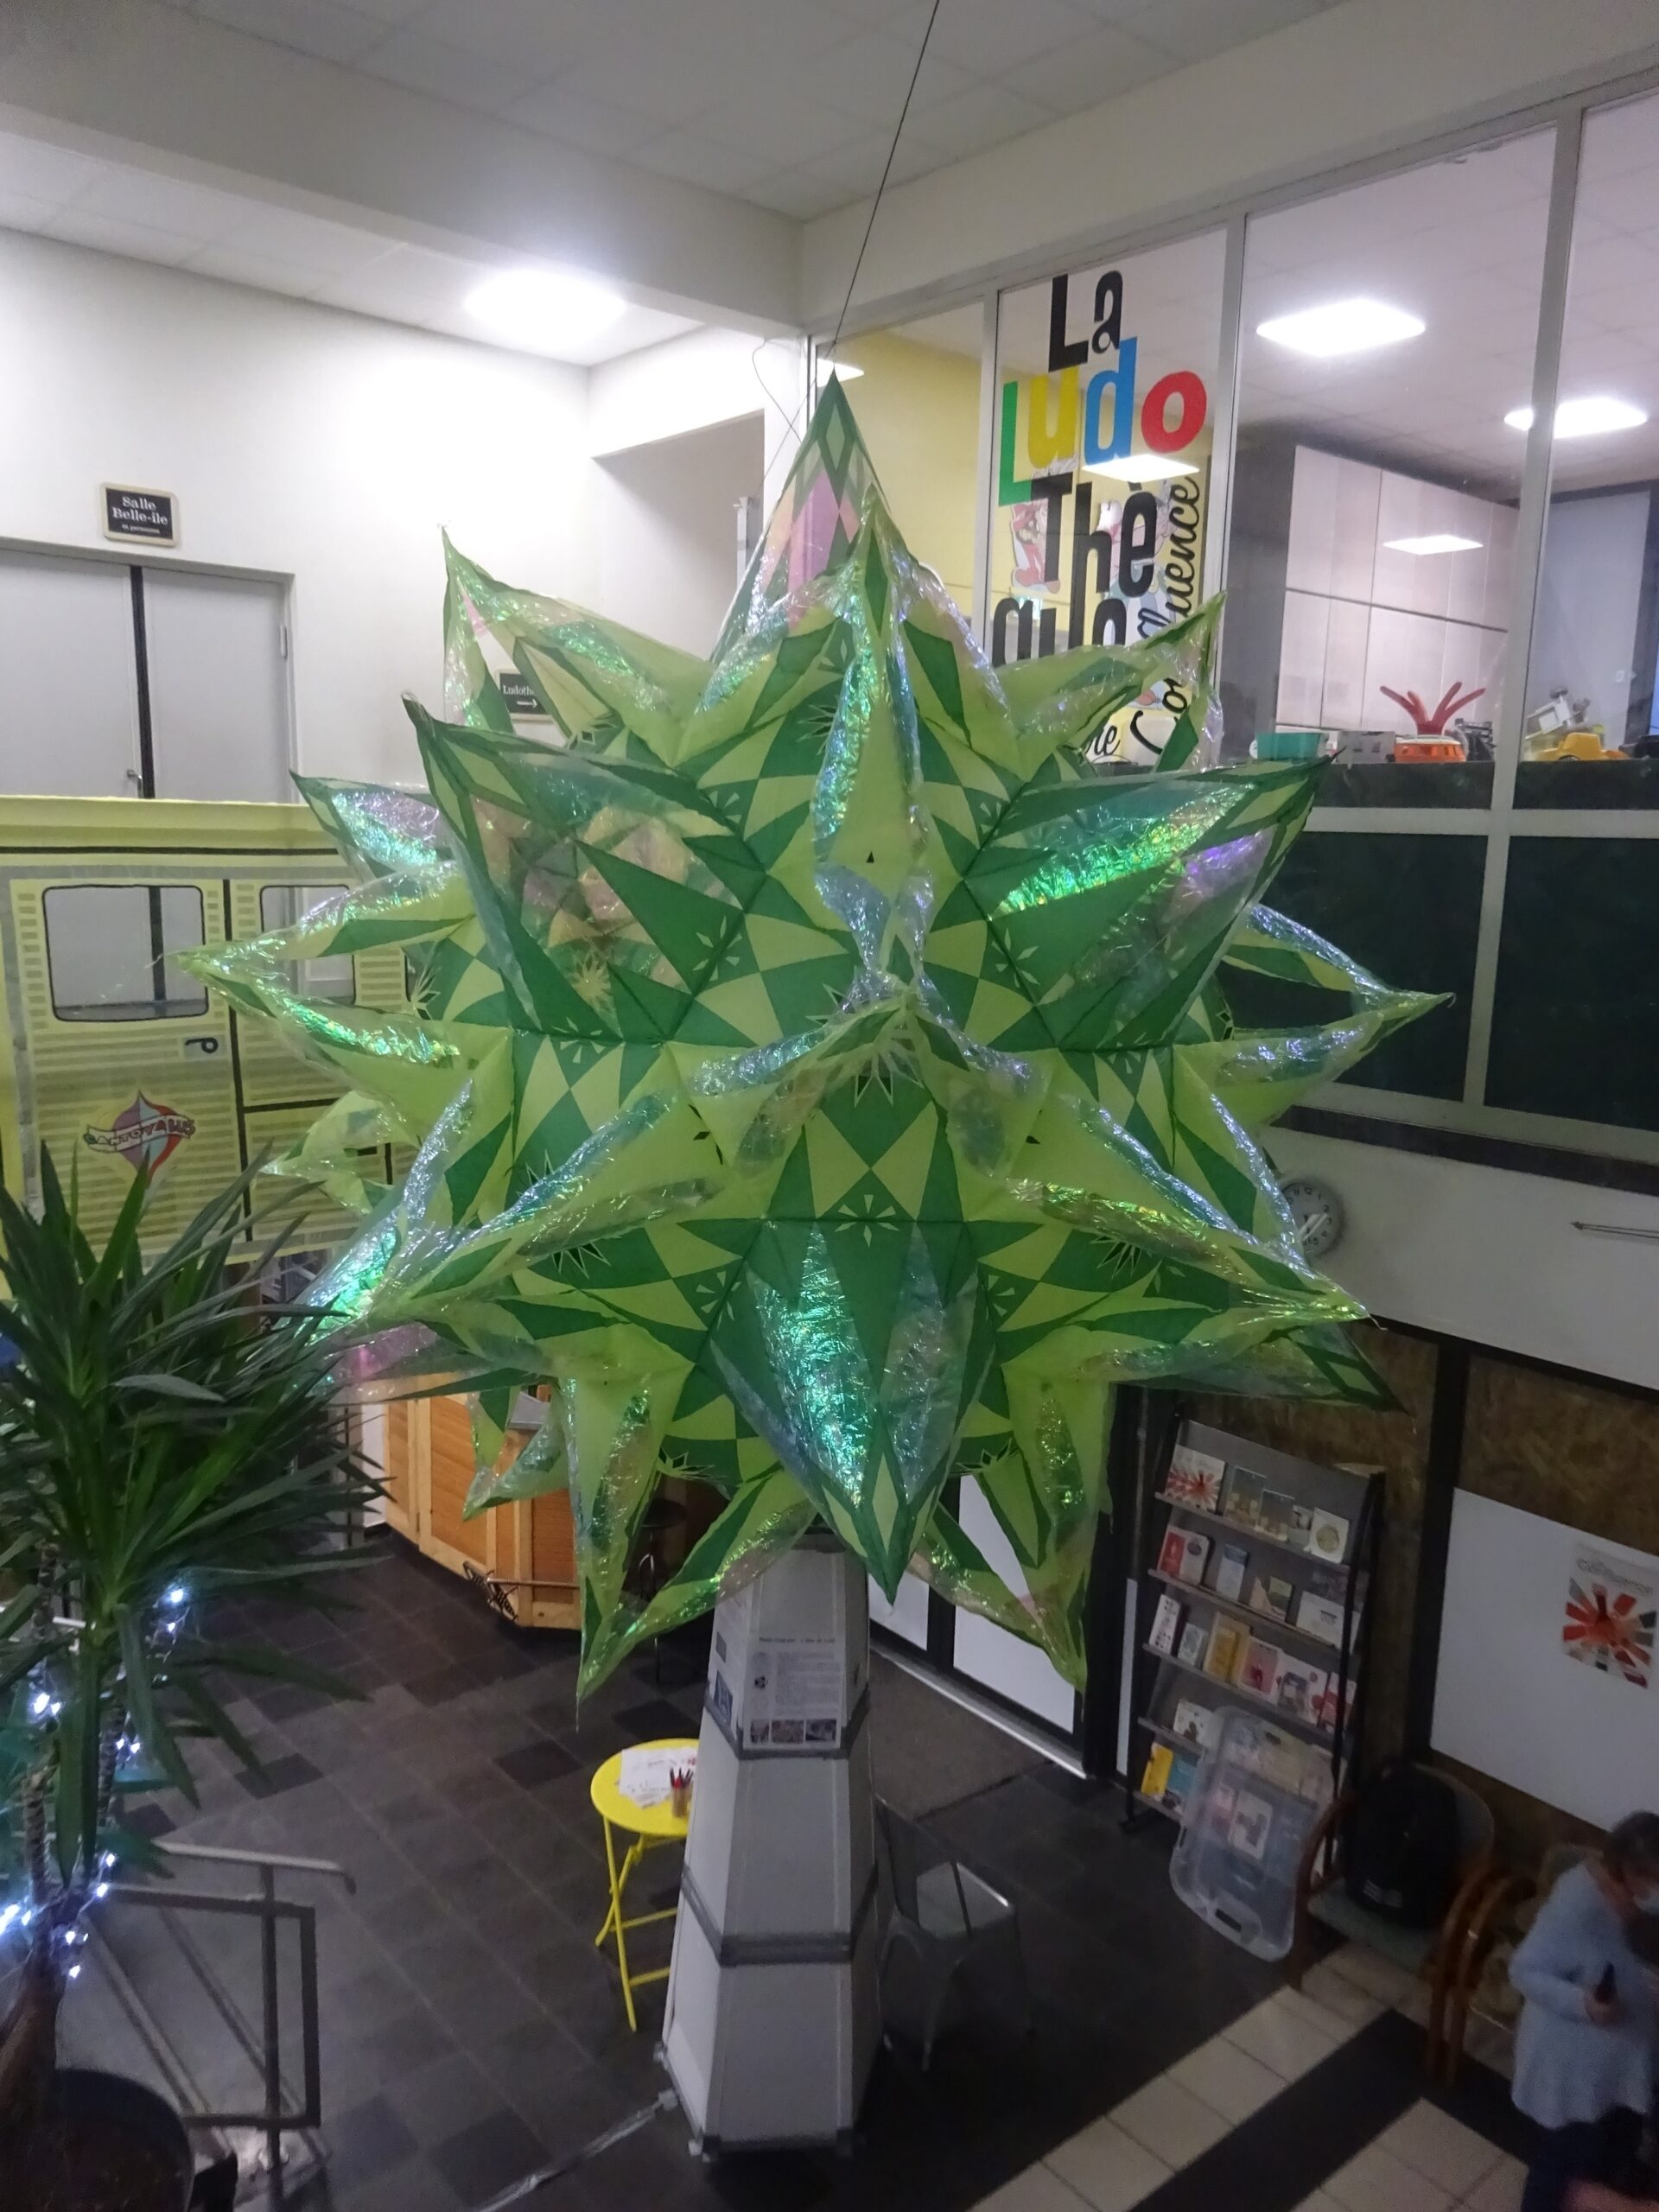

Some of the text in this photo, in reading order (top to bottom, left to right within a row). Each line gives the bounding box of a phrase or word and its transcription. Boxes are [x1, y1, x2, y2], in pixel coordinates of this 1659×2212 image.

[1048, 270, 1122, 372] La
[998, 335, 1207, 506] Ludo
[122, 496, 156, 512] Salle
